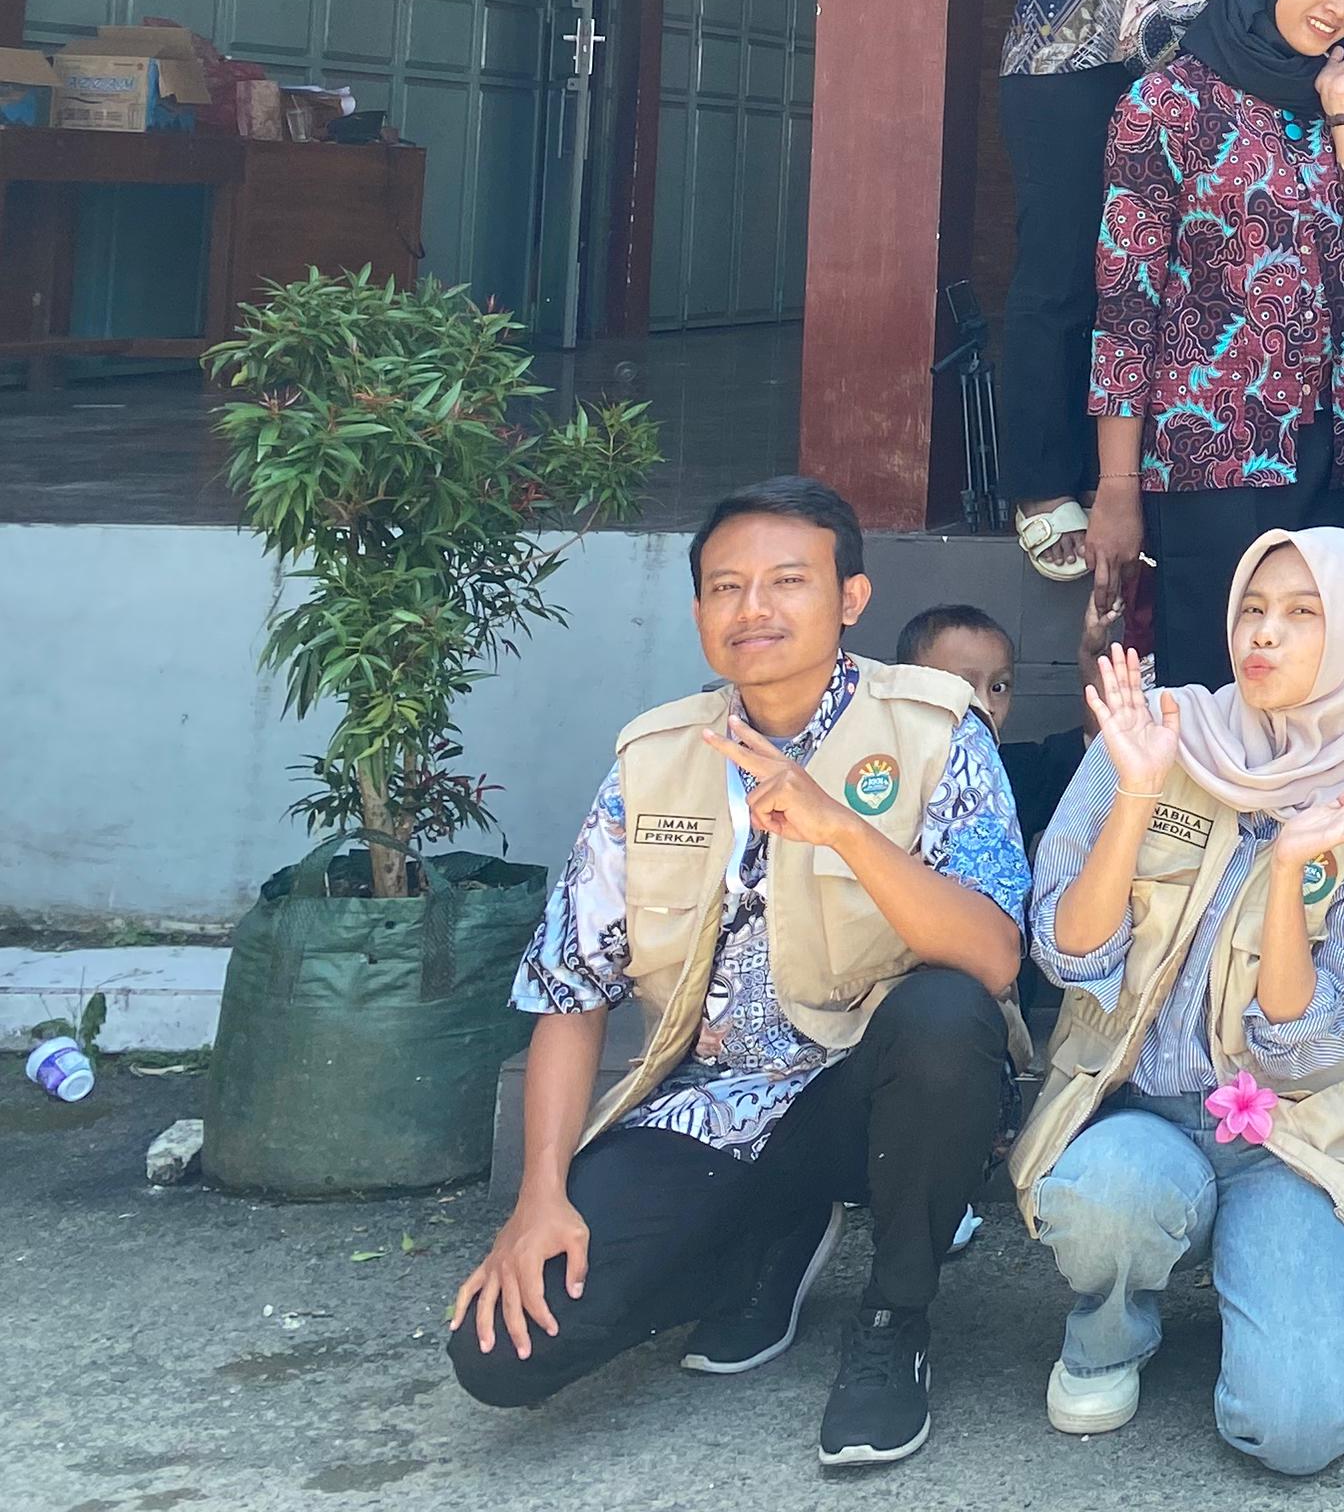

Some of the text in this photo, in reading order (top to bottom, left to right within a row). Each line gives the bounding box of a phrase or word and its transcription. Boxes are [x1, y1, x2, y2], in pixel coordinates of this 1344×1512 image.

[657, 818, 699, 831] IMAM
[1152, 820, 1192, 839] MEDIA
[644, 832, 705, 844] PERKAP
